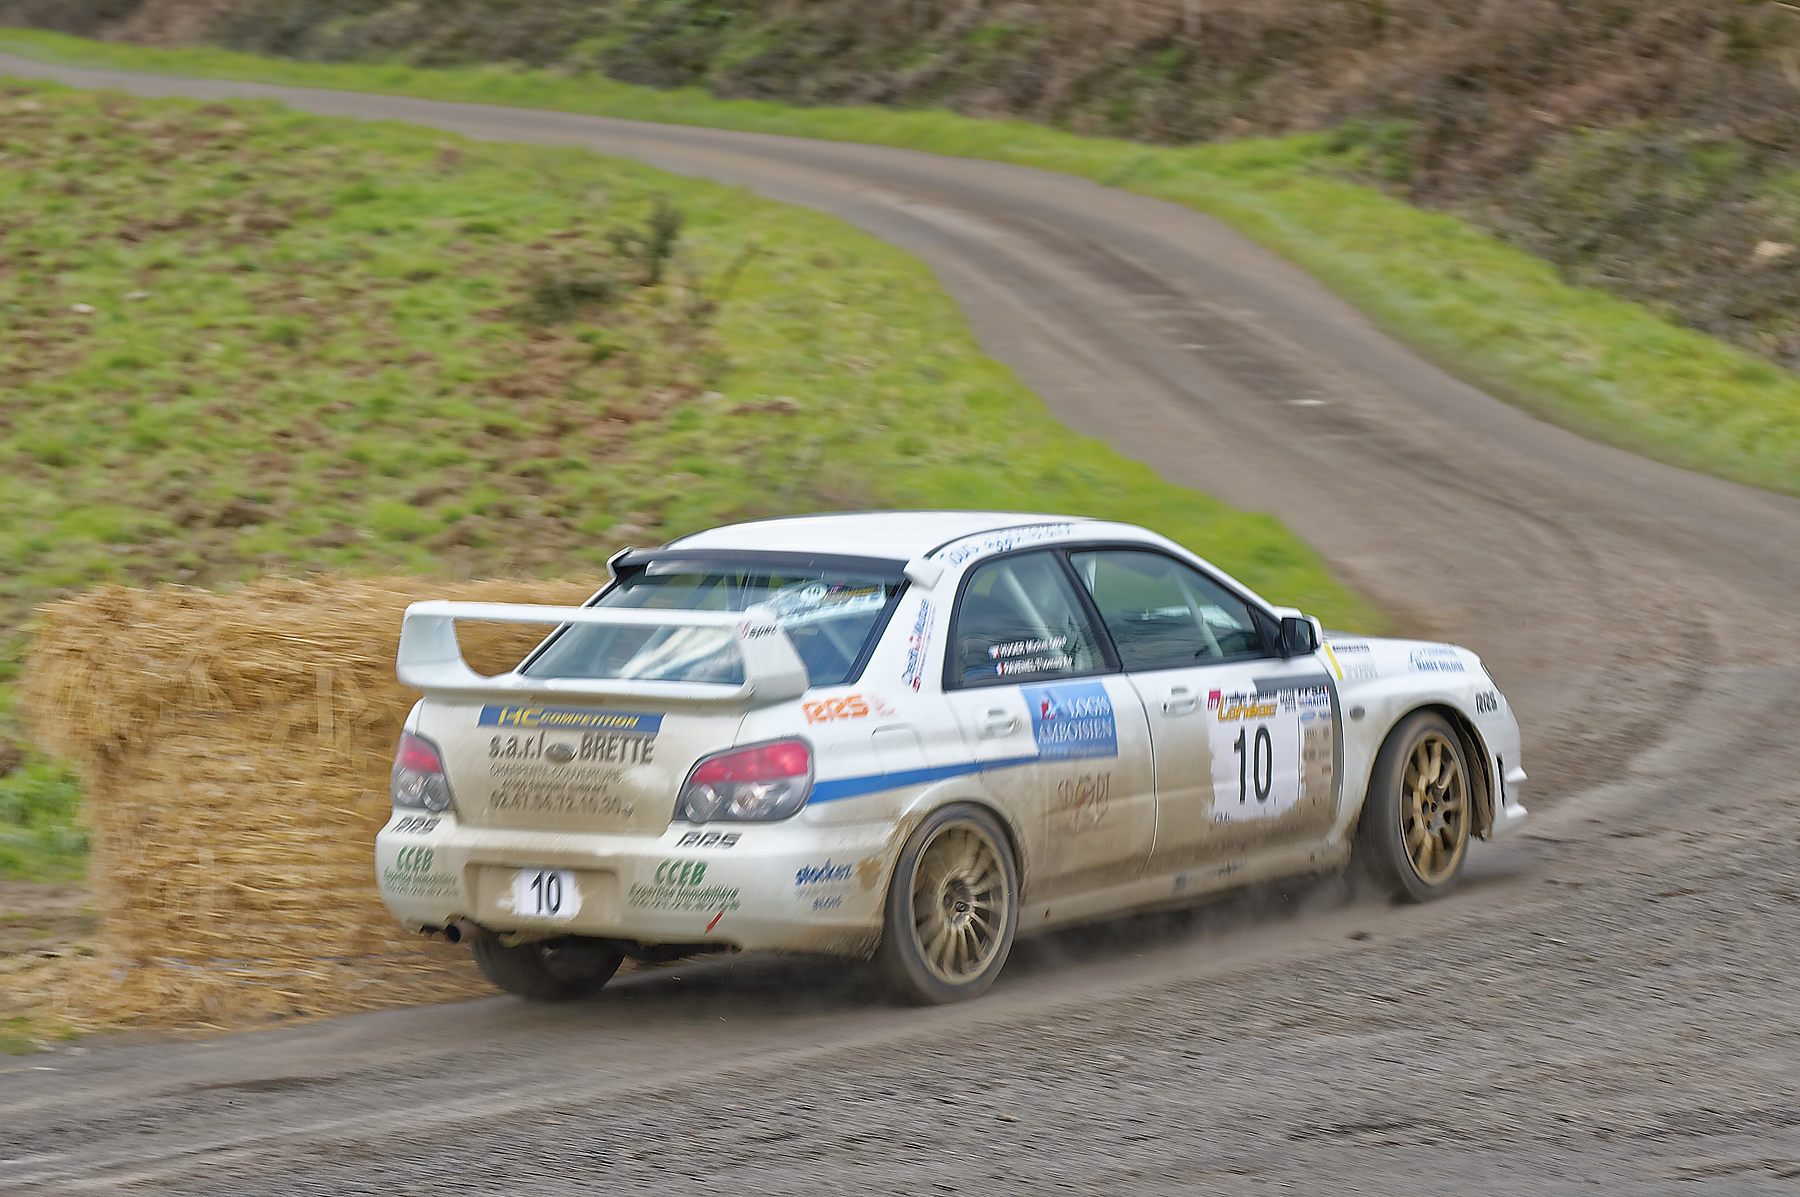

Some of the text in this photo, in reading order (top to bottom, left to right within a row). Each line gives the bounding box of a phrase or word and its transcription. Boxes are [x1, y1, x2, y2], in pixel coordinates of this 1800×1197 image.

[578, 732, 656, 764] BRETTE
[1233, 725, 1274, 805] 10
[397, 846, 434, 873] CCEB
[655, 858, 708, 886] CCEB
[529, 871, 563, 916] 10
